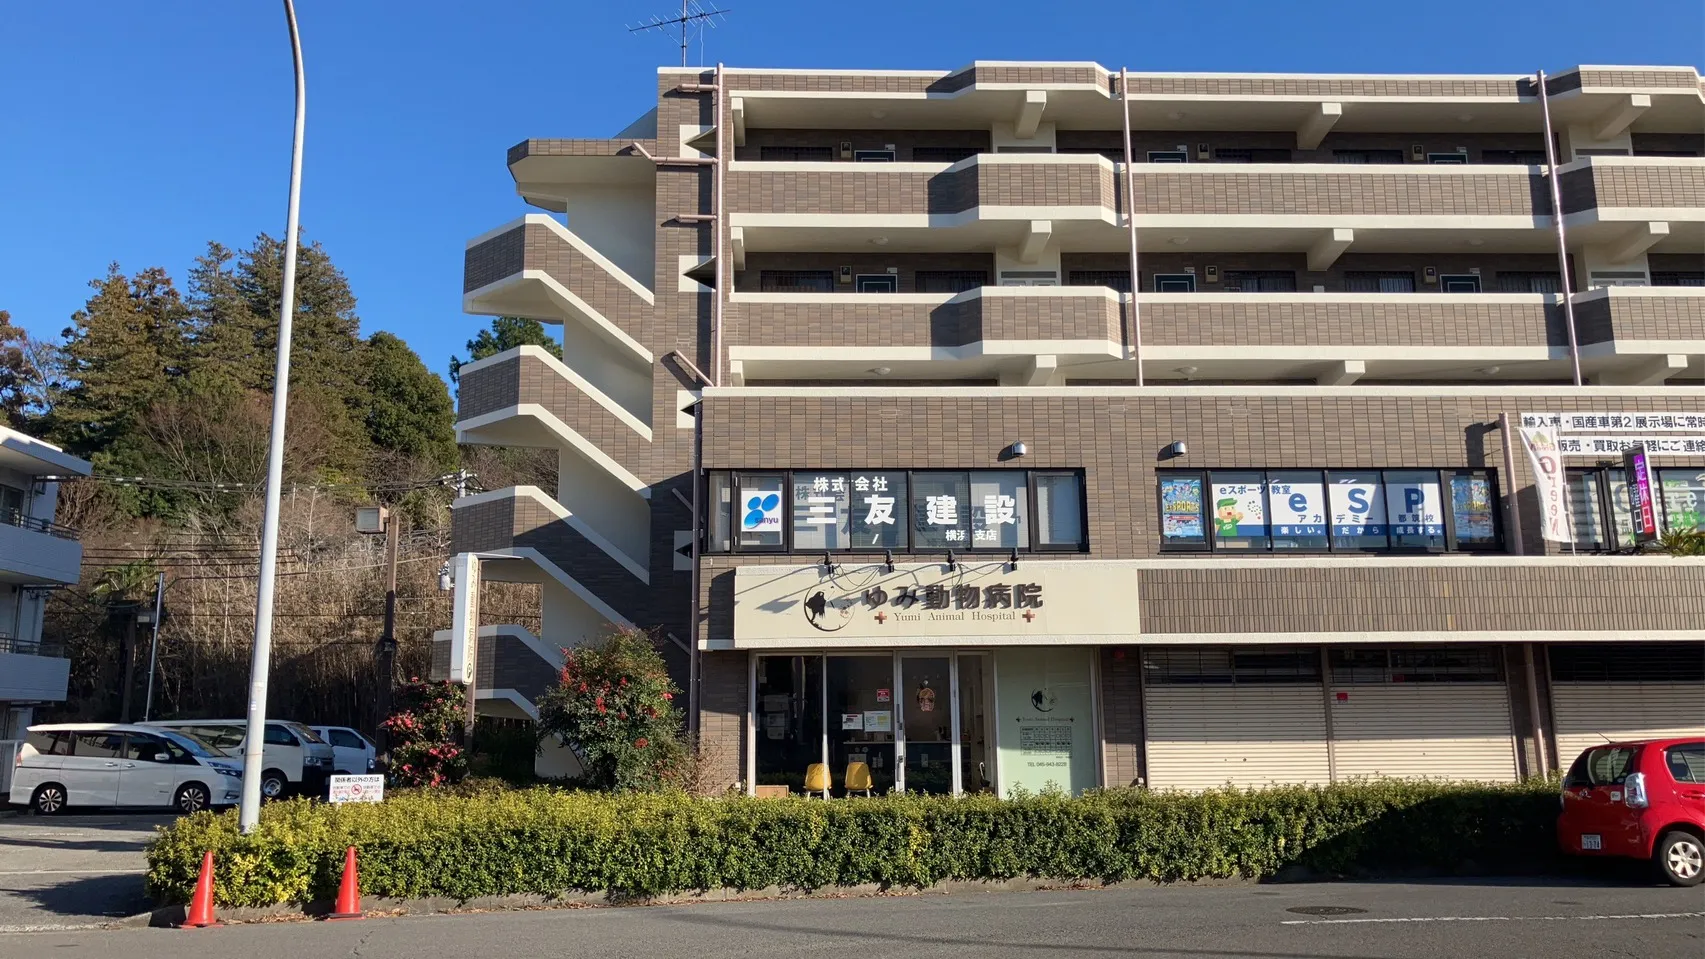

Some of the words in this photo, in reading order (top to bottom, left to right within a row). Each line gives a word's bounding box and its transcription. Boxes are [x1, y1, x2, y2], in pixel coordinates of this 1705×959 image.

[813, 476, 888, 492] 株式会社
[864, 583, 1043, 610] ゆみ動物病院
[893, 612, 921, 621] Yumi
[928, 611, 964, 621] Animal
[972, 611, 1016, 622] Hospital
